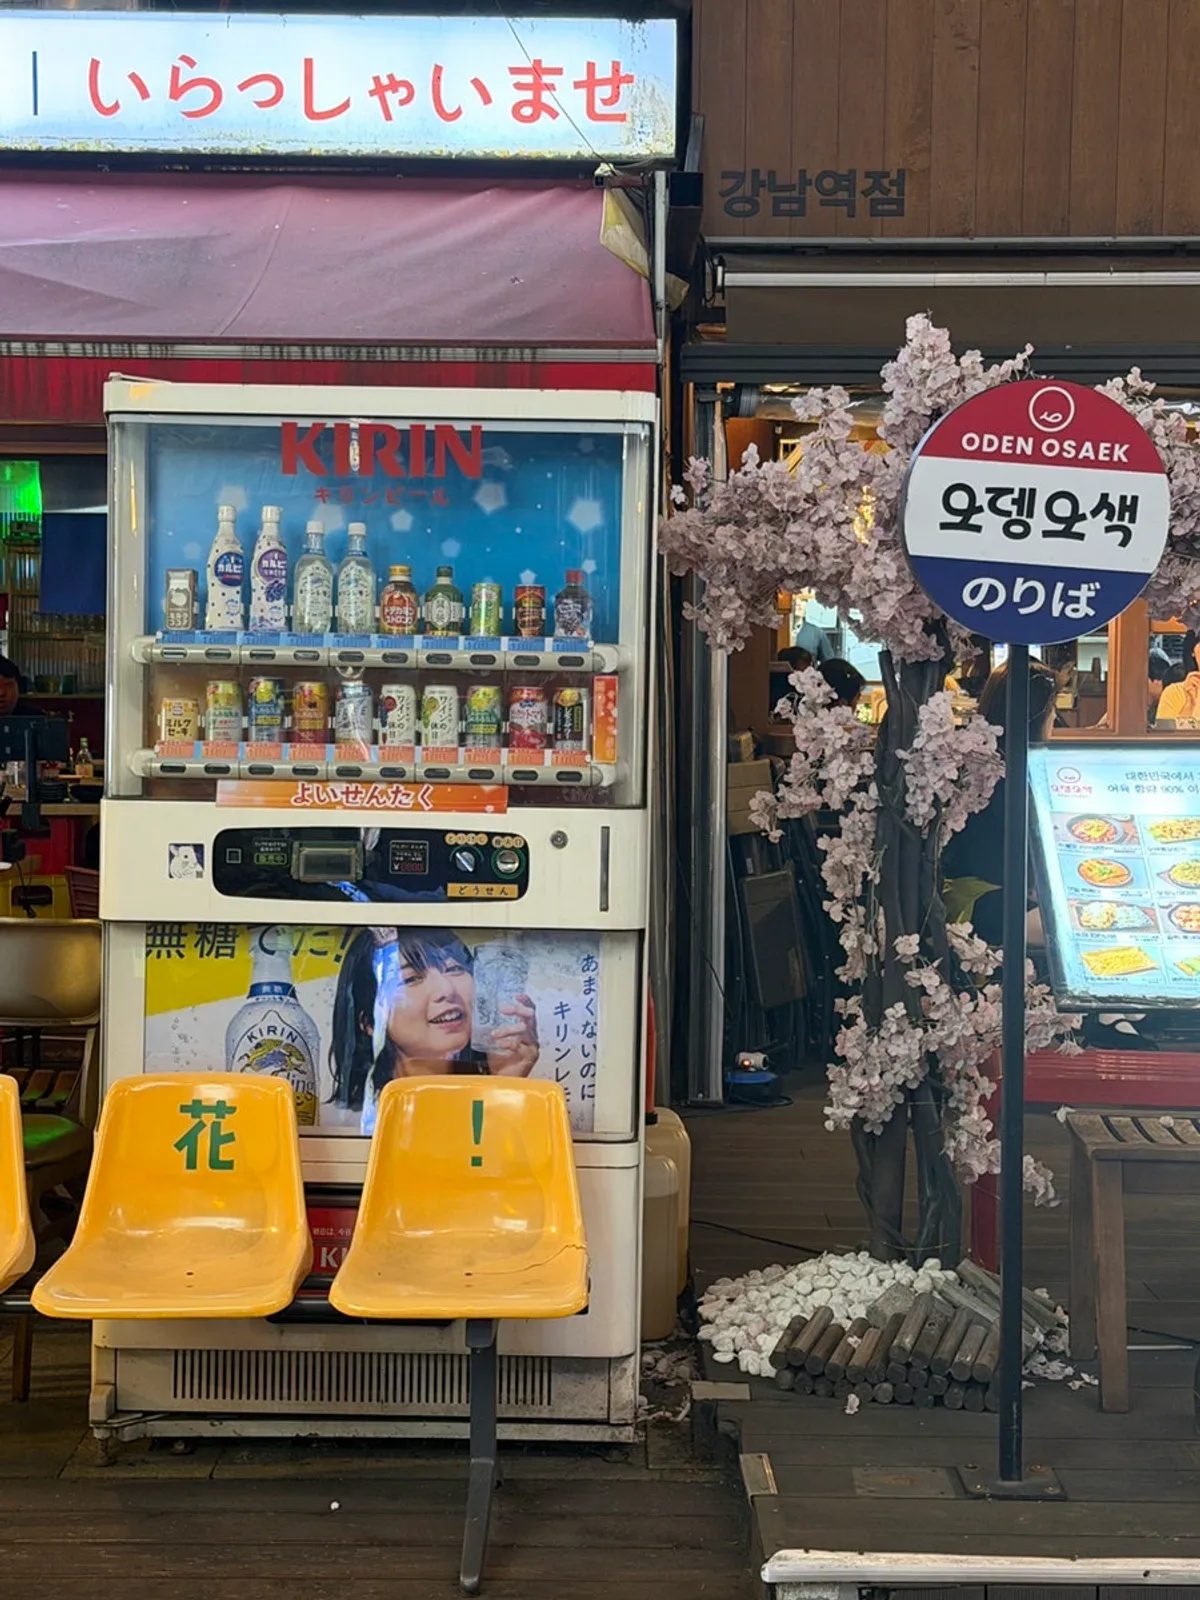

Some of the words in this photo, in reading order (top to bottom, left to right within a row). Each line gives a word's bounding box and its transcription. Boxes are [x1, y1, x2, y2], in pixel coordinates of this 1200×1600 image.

[88, 55, 635, 123] いらっしゃいませ
[719, 168, 907, 219] 강남역점
[281, 422, 483, 479] KIRIN
[961, 432, 1034, 457] ODEN
[1041, 436, 1131, 464] OSAEK
[314, 486, 450, 507] キリンビール
[938, 481, 1140, 550] 오뎅오색
[961, 576, 1103, 619] のりば
[291, 781, 434, 810] よいせんたく
[246, 1024, 298, 1043] KIRIN
[580, 954, 599, 1101] あまくないのに
[174, 1099, 236, 1171] 花
